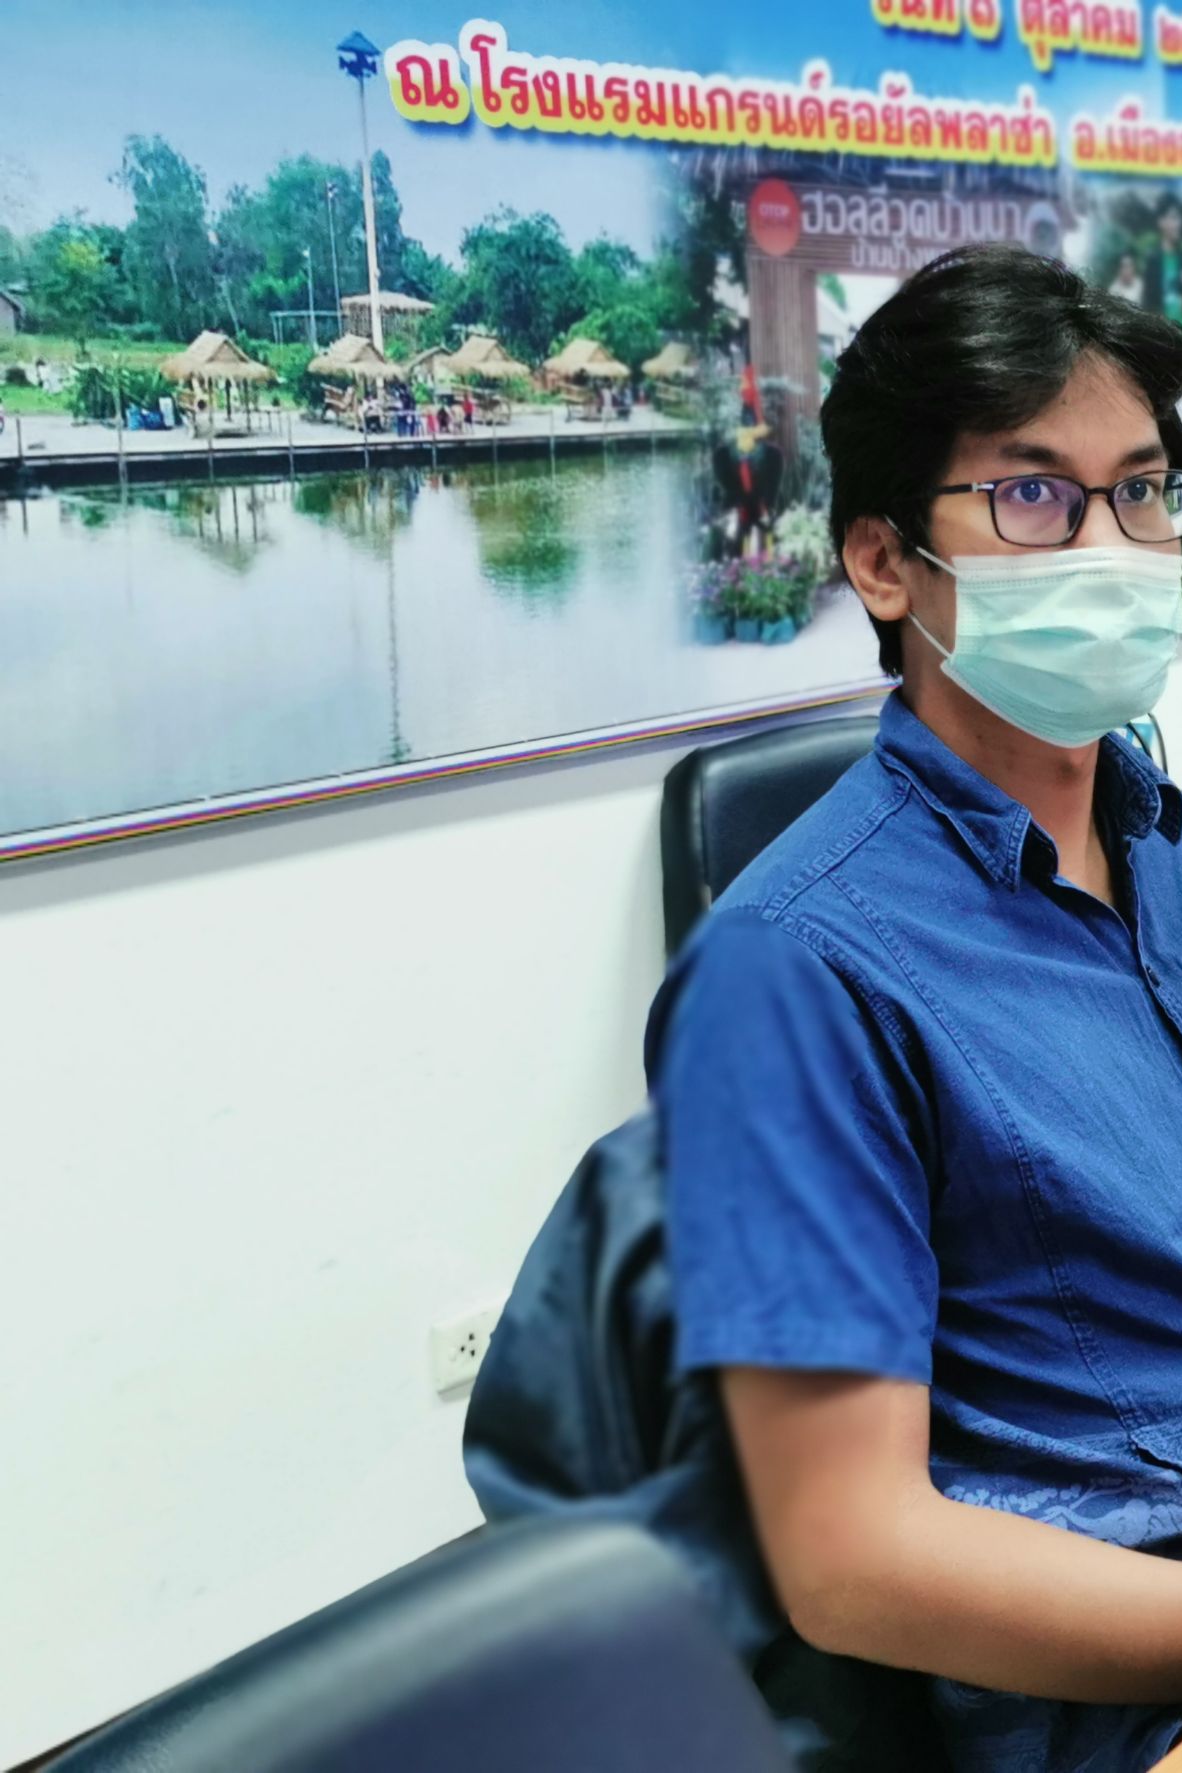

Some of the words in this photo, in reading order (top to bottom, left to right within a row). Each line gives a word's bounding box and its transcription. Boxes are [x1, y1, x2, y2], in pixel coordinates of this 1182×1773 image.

[1020, 0, 1139, 62] ตุลาคม
[395, 51, 462, 110] ณ
